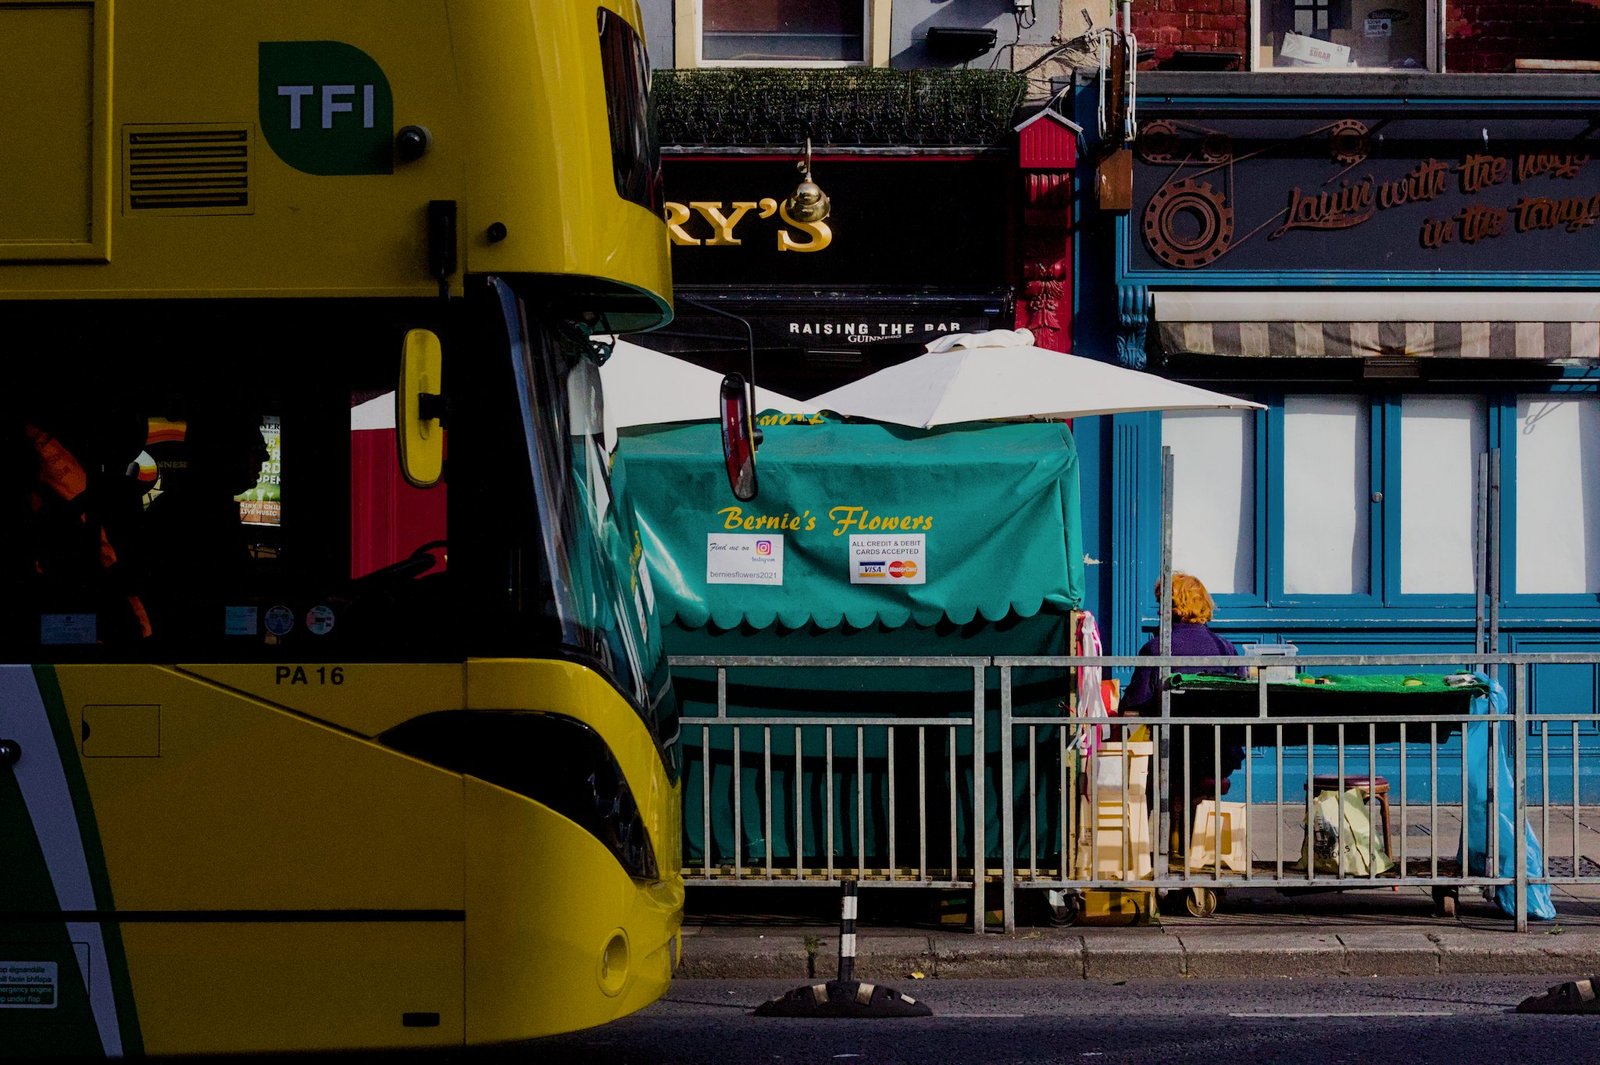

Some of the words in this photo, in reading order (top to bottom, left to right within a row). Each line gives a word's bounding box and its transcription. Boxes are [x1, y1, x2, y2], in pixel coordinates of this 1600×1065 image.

[277, 84, 374, 129] TFI
[1378, 157, 1449, 210] with
[1450, 151, 1507, 194] the
[1453, 203, 1509, 245] the
[789, 322, 869, 337] RAISING
[878, 322, 914, 336] THE
[924, 322, 961, 333] BAR
[717, 506, 817, 531] Bernie's
[828, 506, 934, 537] Flowers
[709, 542, 727, 551] Find
[709, 571, 778, 580] berniesflowers2021
[275, 666, 309, 686] PA
[316, 666, 345, 686] 16
